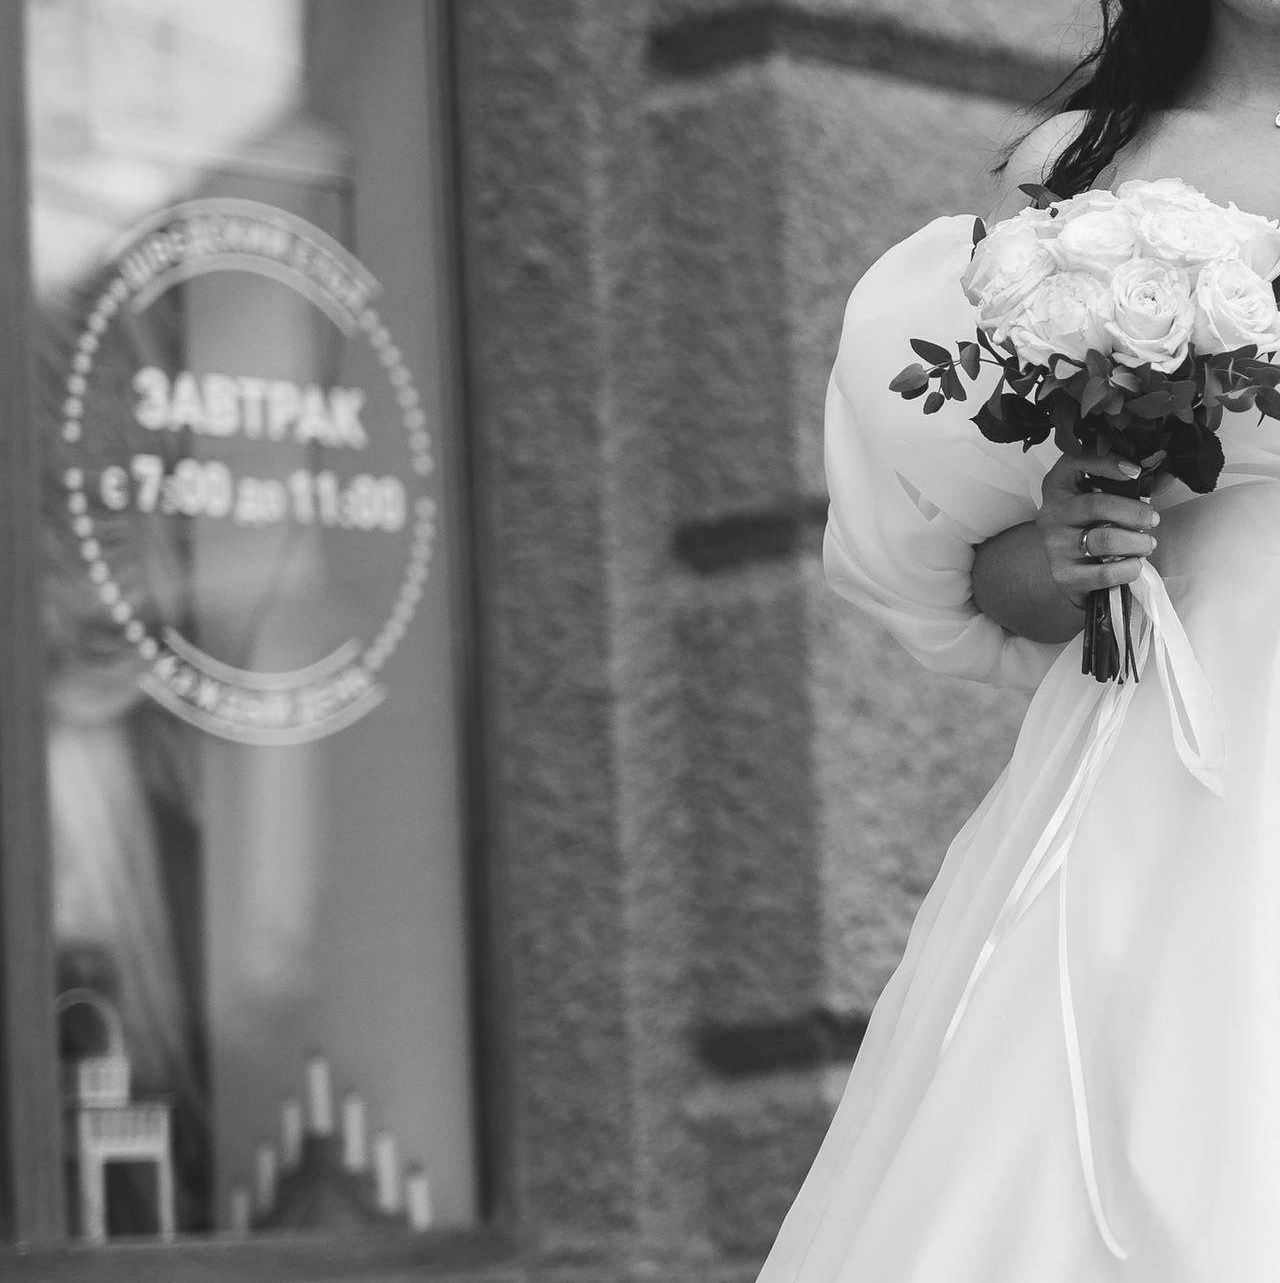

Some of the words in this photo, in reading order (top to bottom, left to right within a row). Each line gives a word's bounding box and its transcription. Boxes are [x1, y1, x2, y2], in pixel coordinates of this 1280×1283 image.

[133, 366, 369, 450] ЗАВТРАК
[131, 453, 233, 518] 7:00
[288, 468, 405, 532] 11:00
